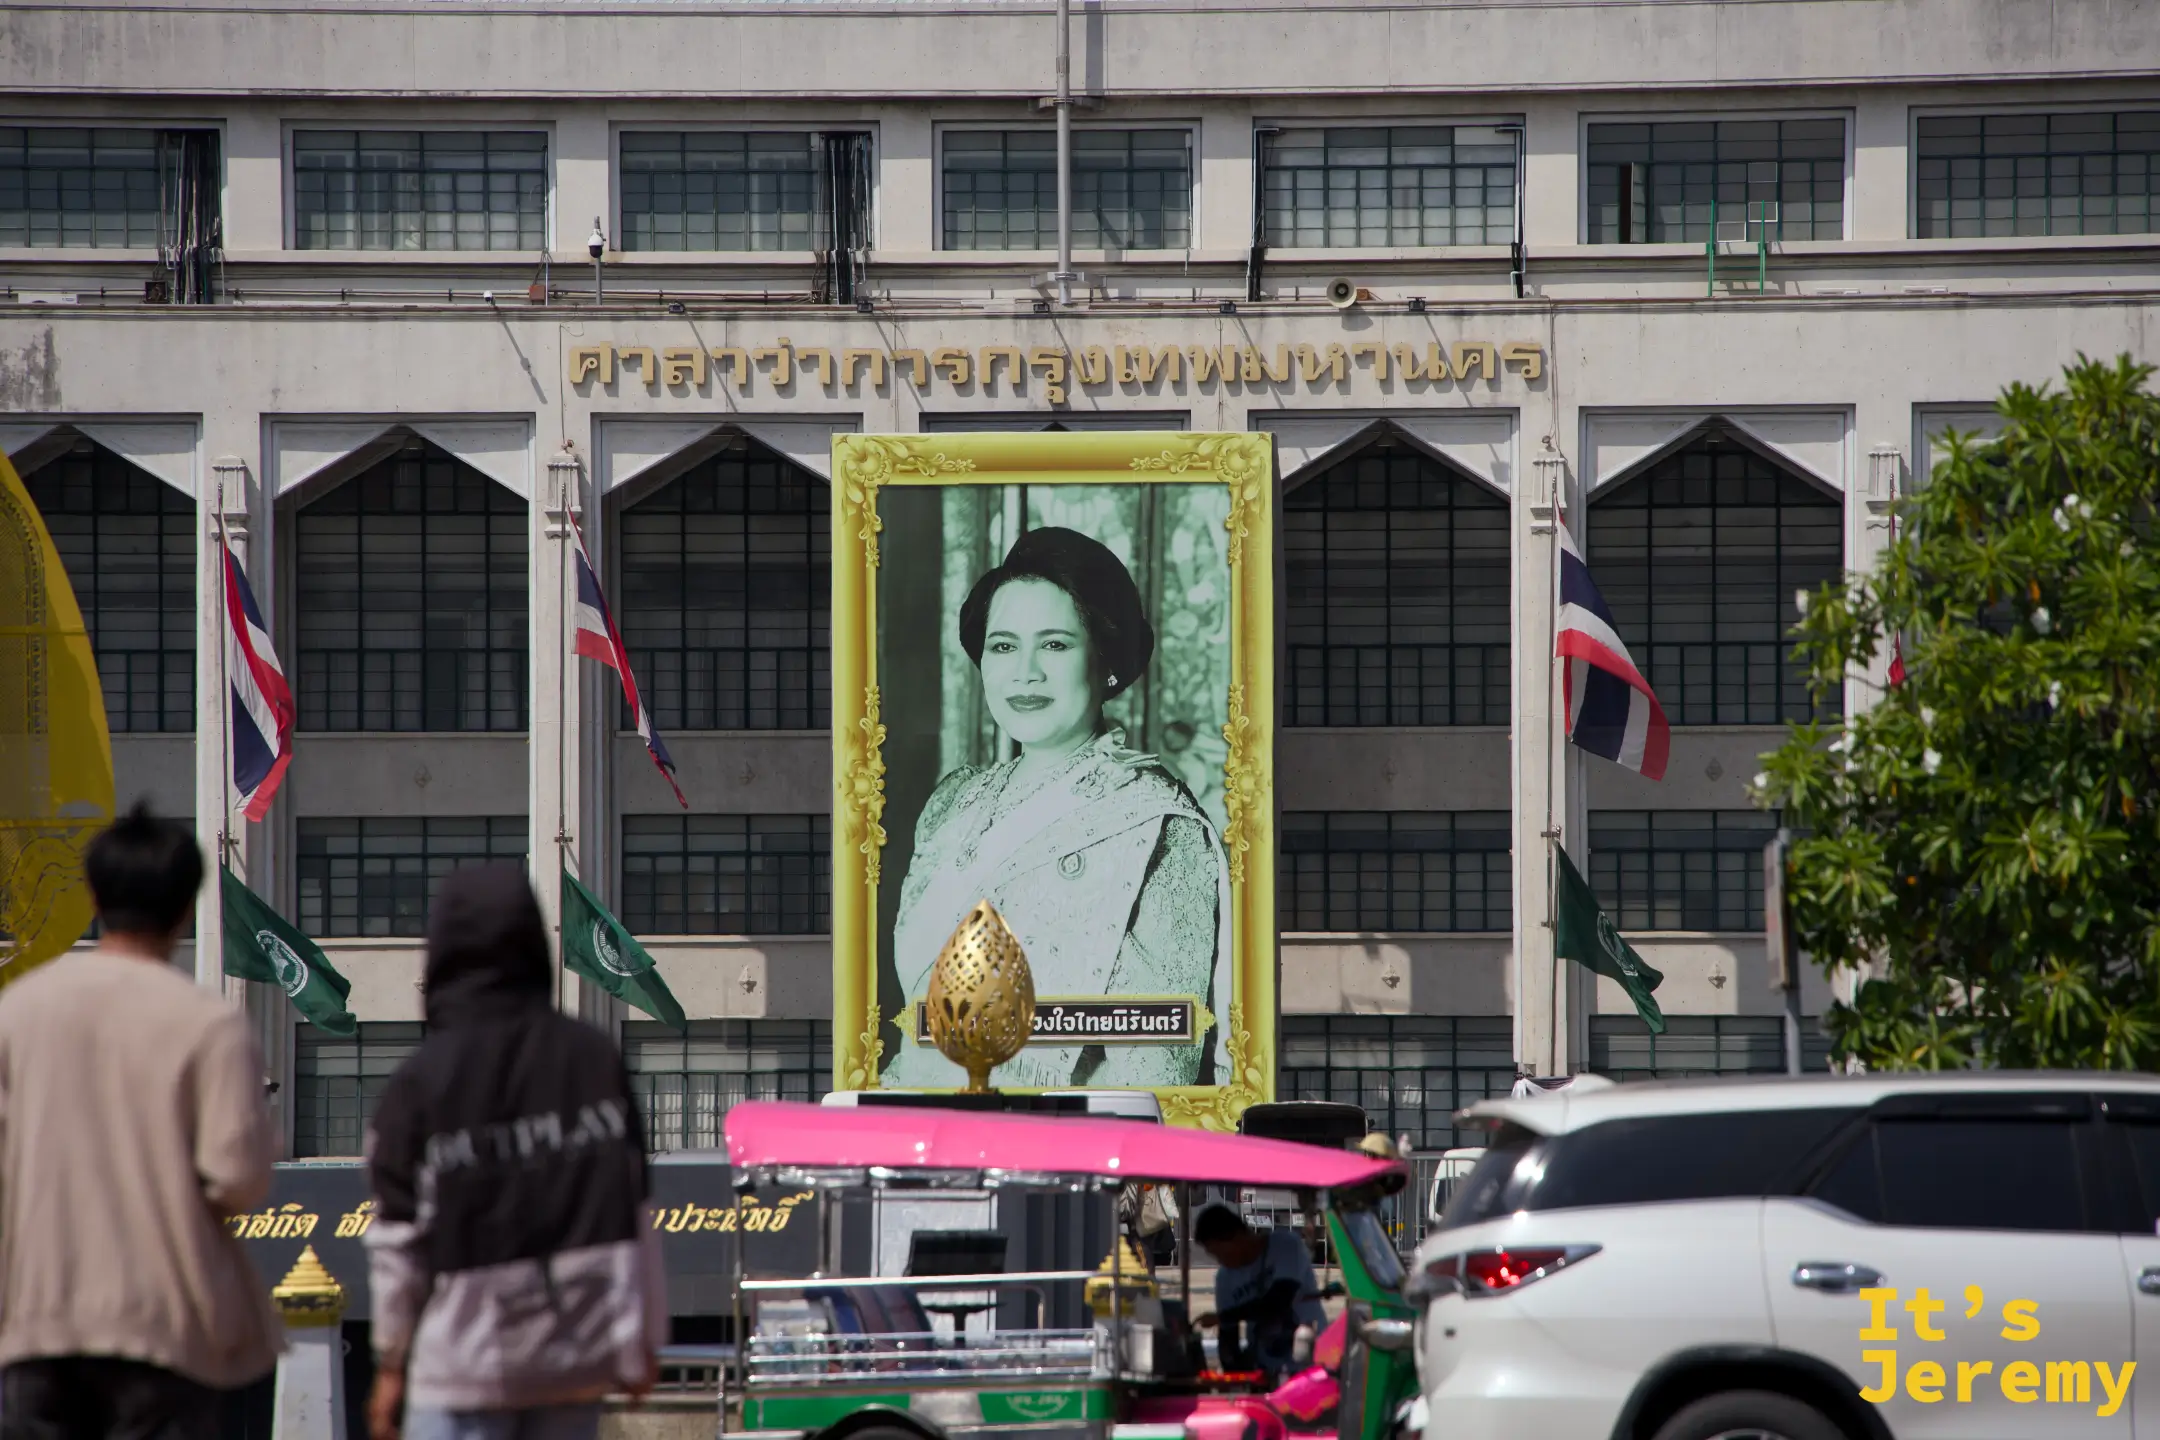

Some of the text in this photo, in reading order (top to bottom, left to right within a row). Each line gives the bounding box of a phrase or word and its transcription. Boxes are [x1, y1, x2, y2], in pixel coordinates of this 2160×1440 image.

[569, 336, 1543, 404] ศาลาว่าการกรุงเทพมหานคร
[1033, 1006, 1182, 1032] วงใจไทยนิรันดร์
